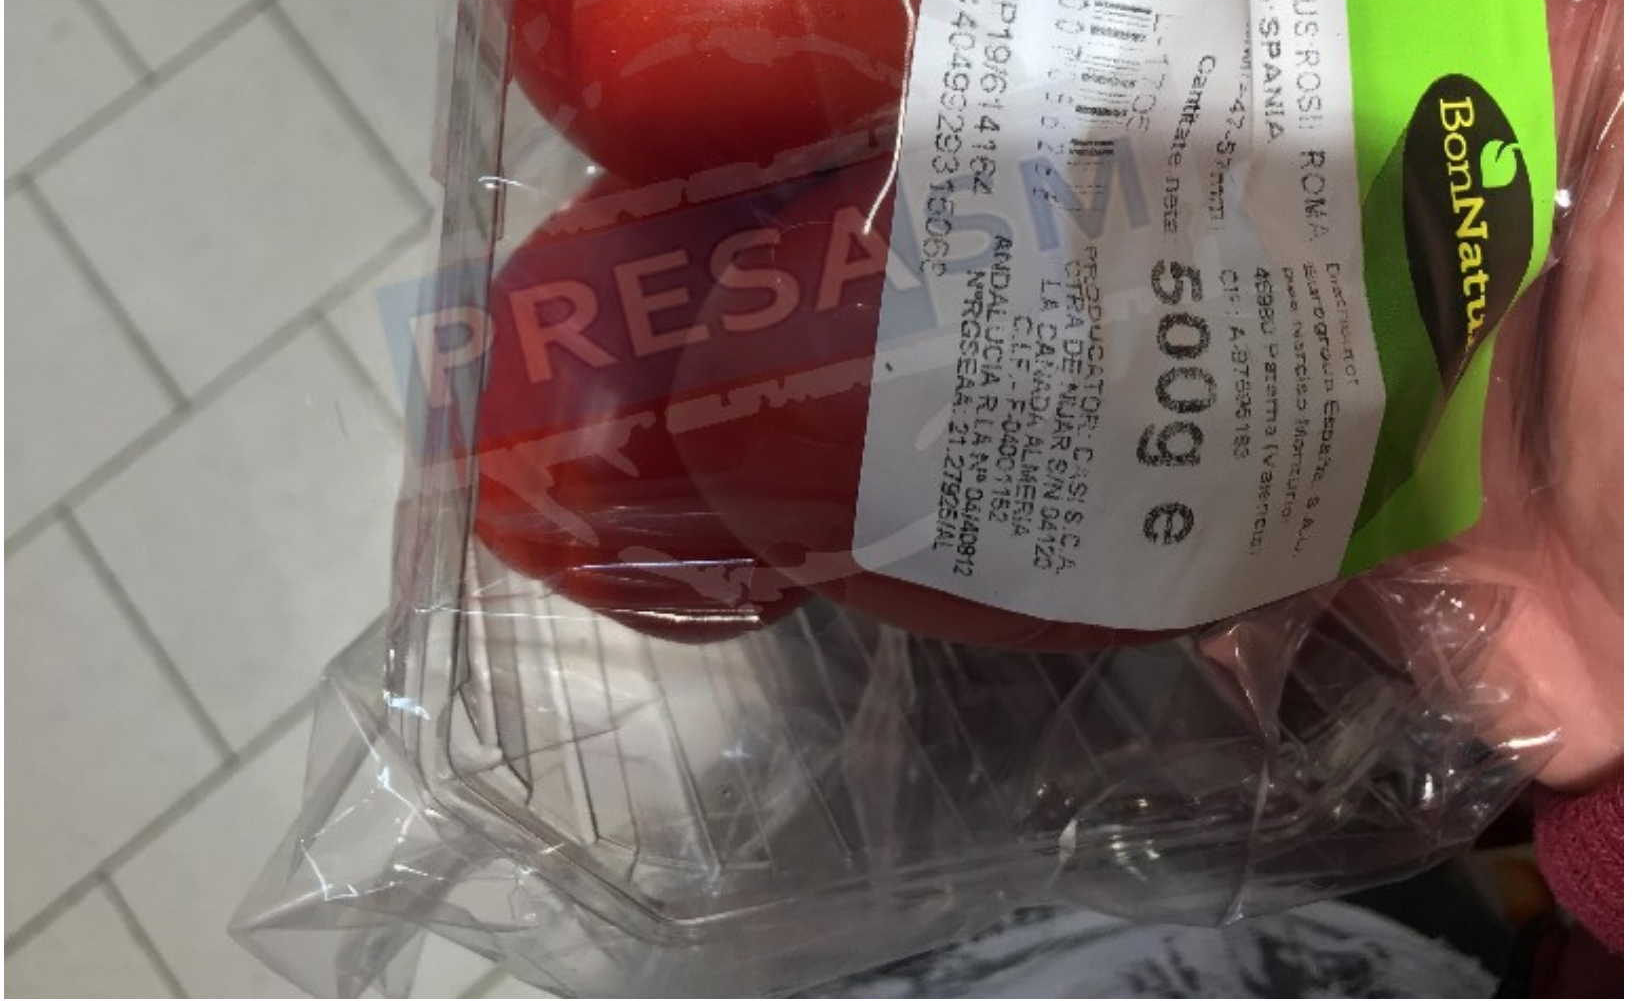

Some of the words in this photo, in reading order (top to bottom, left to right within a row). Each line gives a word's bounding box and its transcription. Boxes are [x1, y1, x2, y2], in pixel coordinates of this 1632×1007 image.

[1256, 16, 1285, 145] SPANIA
[1298, 149, 1329, 243] ROMA
[978, 234, 1013, 387] ANDALUCIA
[1038, 277, 1061, 313] LA
[1062, 259, 1085, 331] CTRA
[1060, 338, 1083, 376] DE
[1135, 259, 1218, 468] 500g
